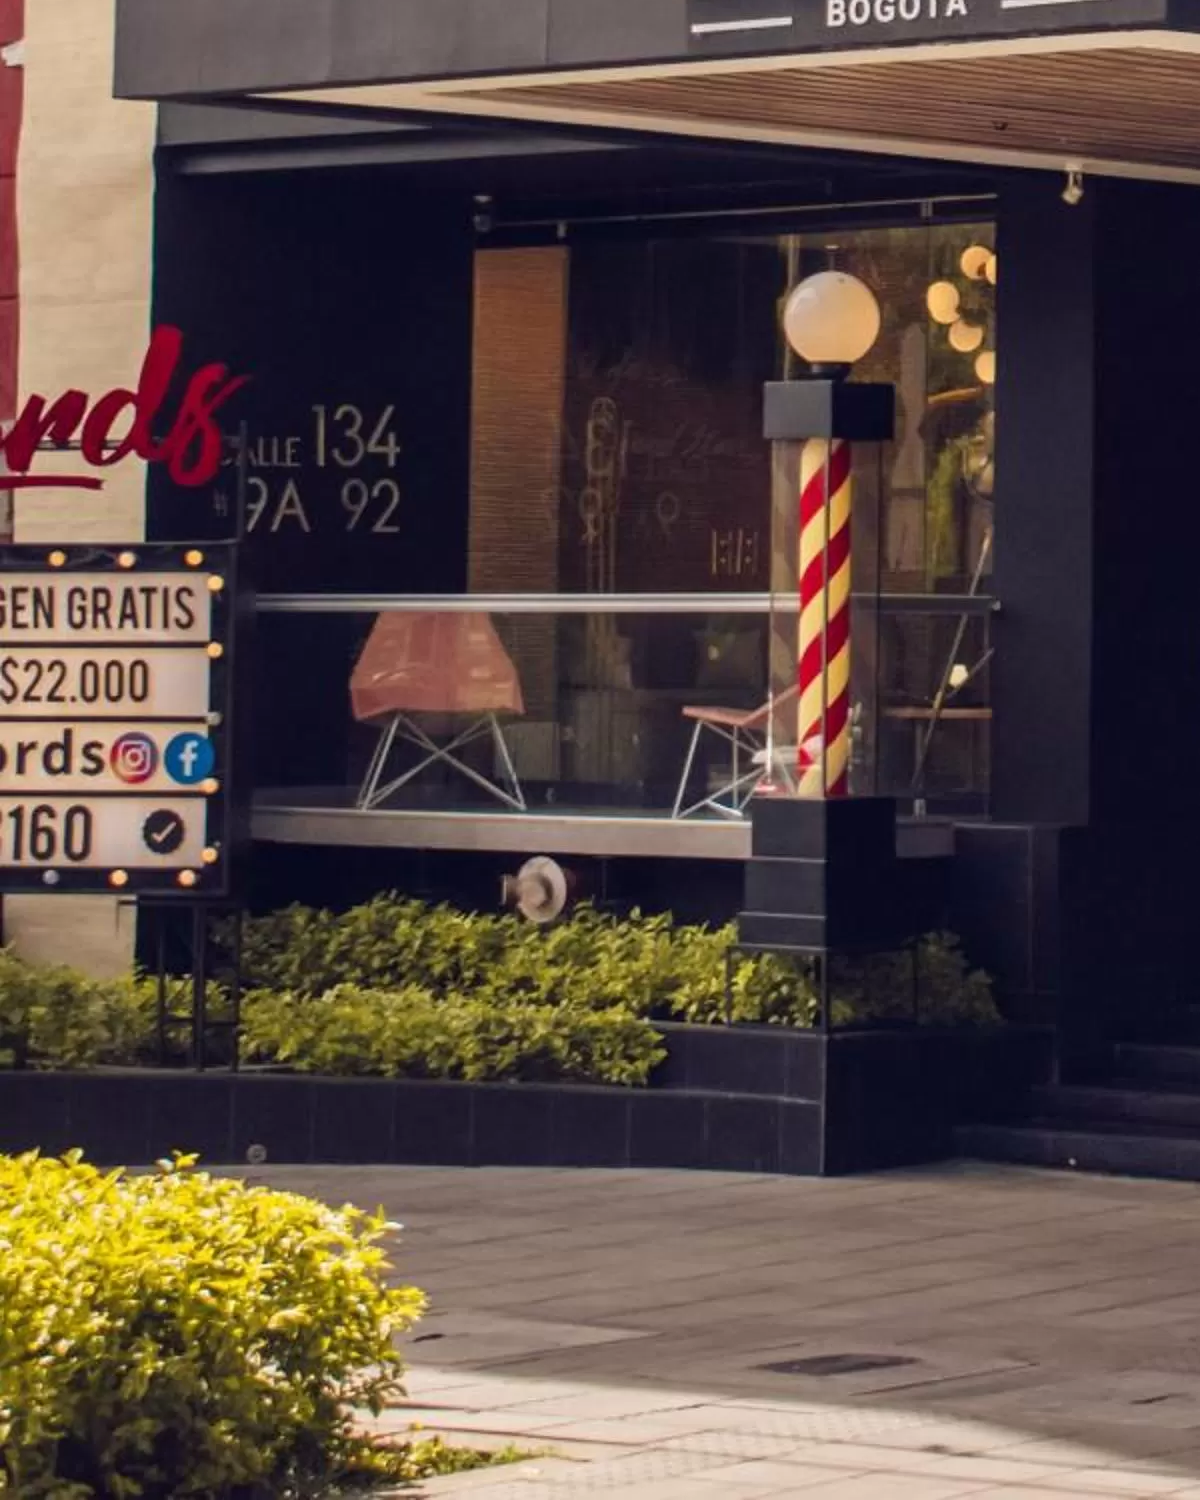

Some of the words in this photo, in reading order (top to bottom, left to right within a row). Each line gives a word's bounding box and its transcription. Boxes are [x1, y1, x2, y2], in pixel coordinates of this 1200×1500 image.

[0, 324, 250, 487] rds
[312, 403, 401, 469] 134
[341, 476, 401, 533] 92
[67, 586, 195, 631] GRATIS
[0, 656, 149, 704] $22.000
[0, 804, 92, 861] 160
